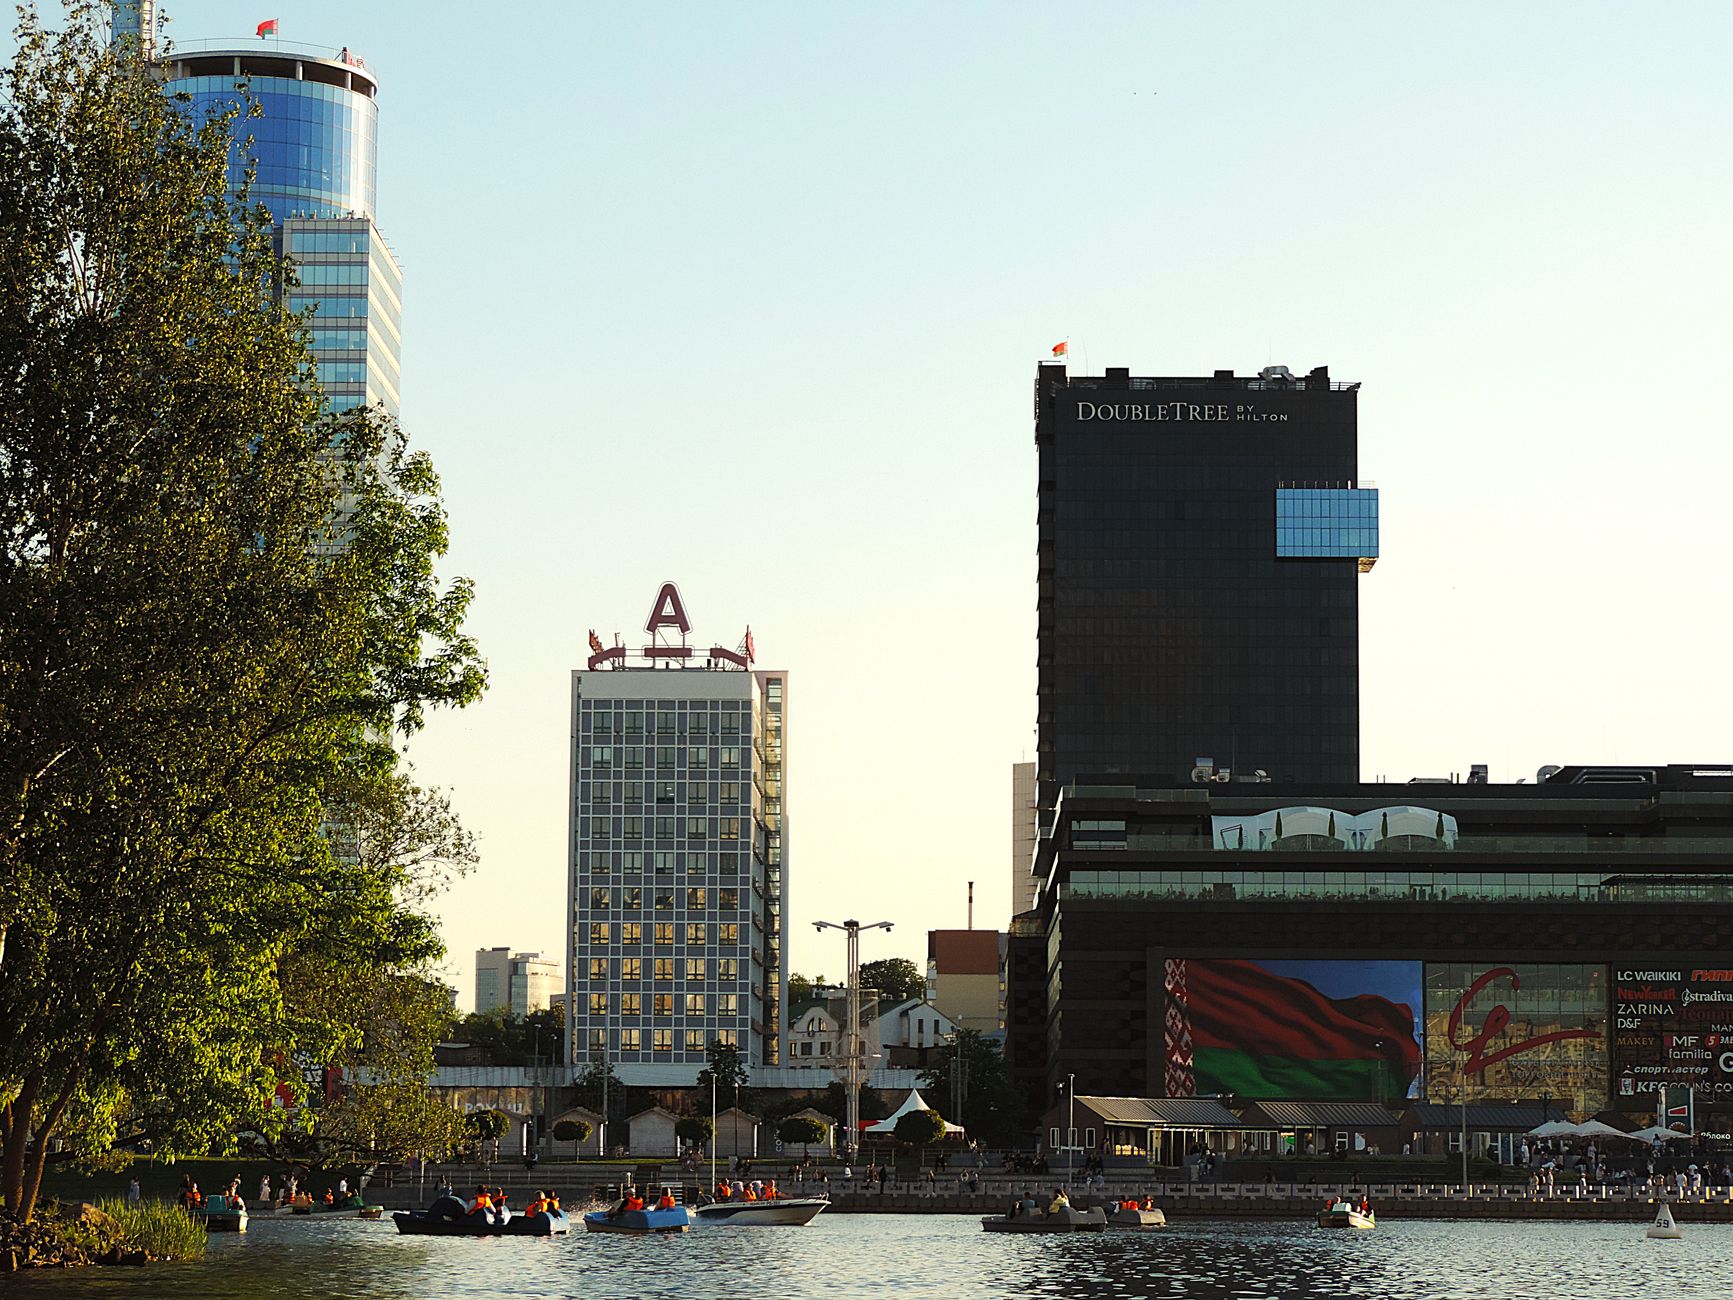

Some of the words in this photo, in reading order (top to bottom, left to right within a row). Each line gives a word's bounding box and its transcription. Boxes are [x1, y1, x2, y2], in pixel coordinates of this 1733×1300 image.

[1617, 971, 1633, 981] LC
[1617, 1004, 1675, 1015] ZARINA
[1617, 1018, 1642, 1029] D&F
[1617, 1037, 1655, 1046] MAKEY
[1672, 1036, 1699, 1047] MF
[1708, 1035, 1716, 1046] 5
[1668, 1048, 1712, 1059] familia
[1635, 1082, 1667, 1093] KFC
[1656, 1219, 1670, 1228] 59
